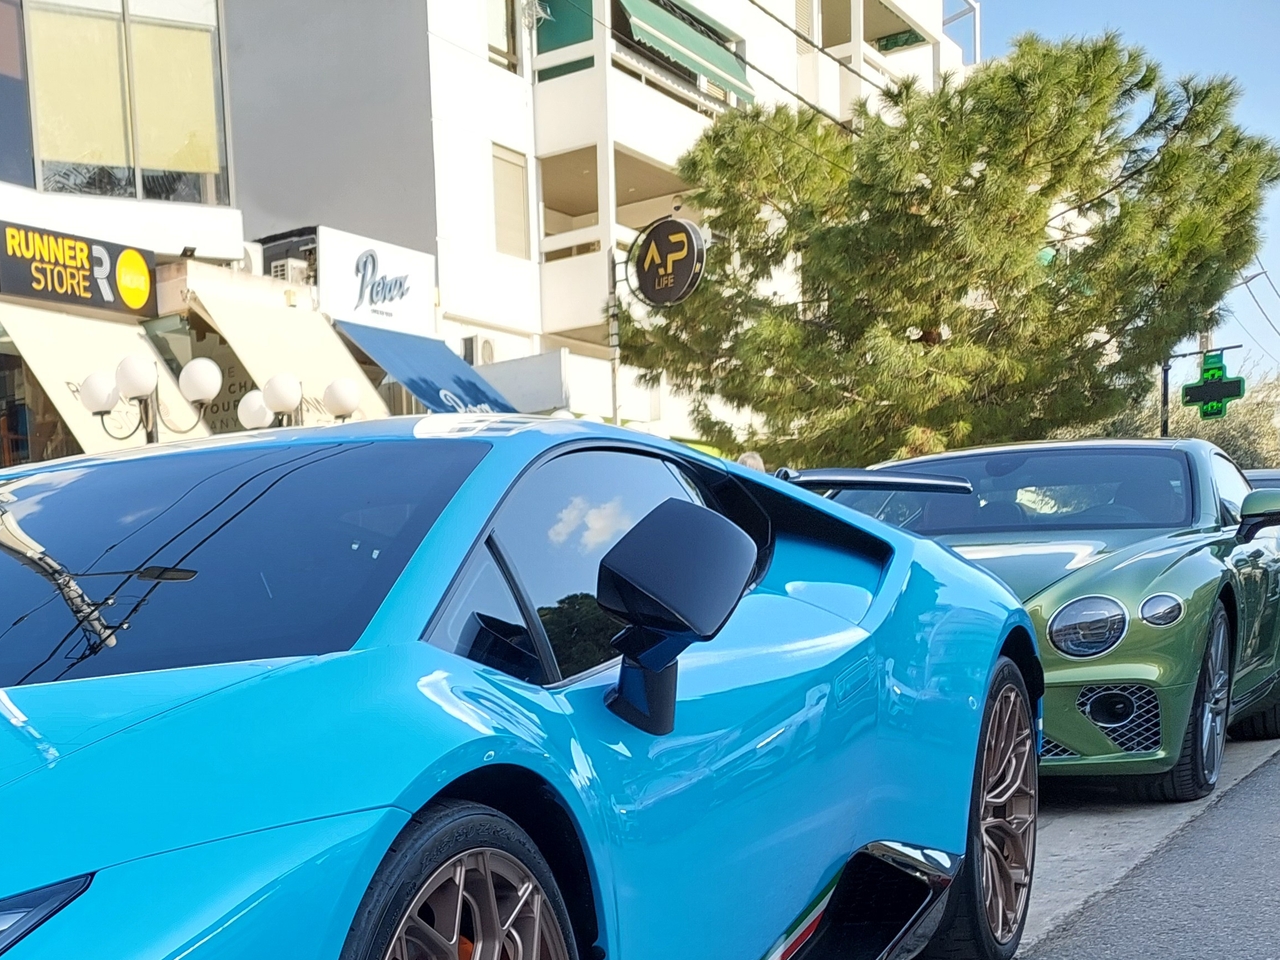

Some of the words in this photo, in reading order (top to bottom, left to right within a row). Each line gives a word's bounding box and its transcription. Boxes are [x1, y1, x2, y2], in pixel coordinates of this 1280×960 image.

[5, 226, 91, 270] RUNNER
[643, 232, 688, 275] AP
[31, 261, 93, 299] STORE
[655, 275, 675, 291] LIFE
